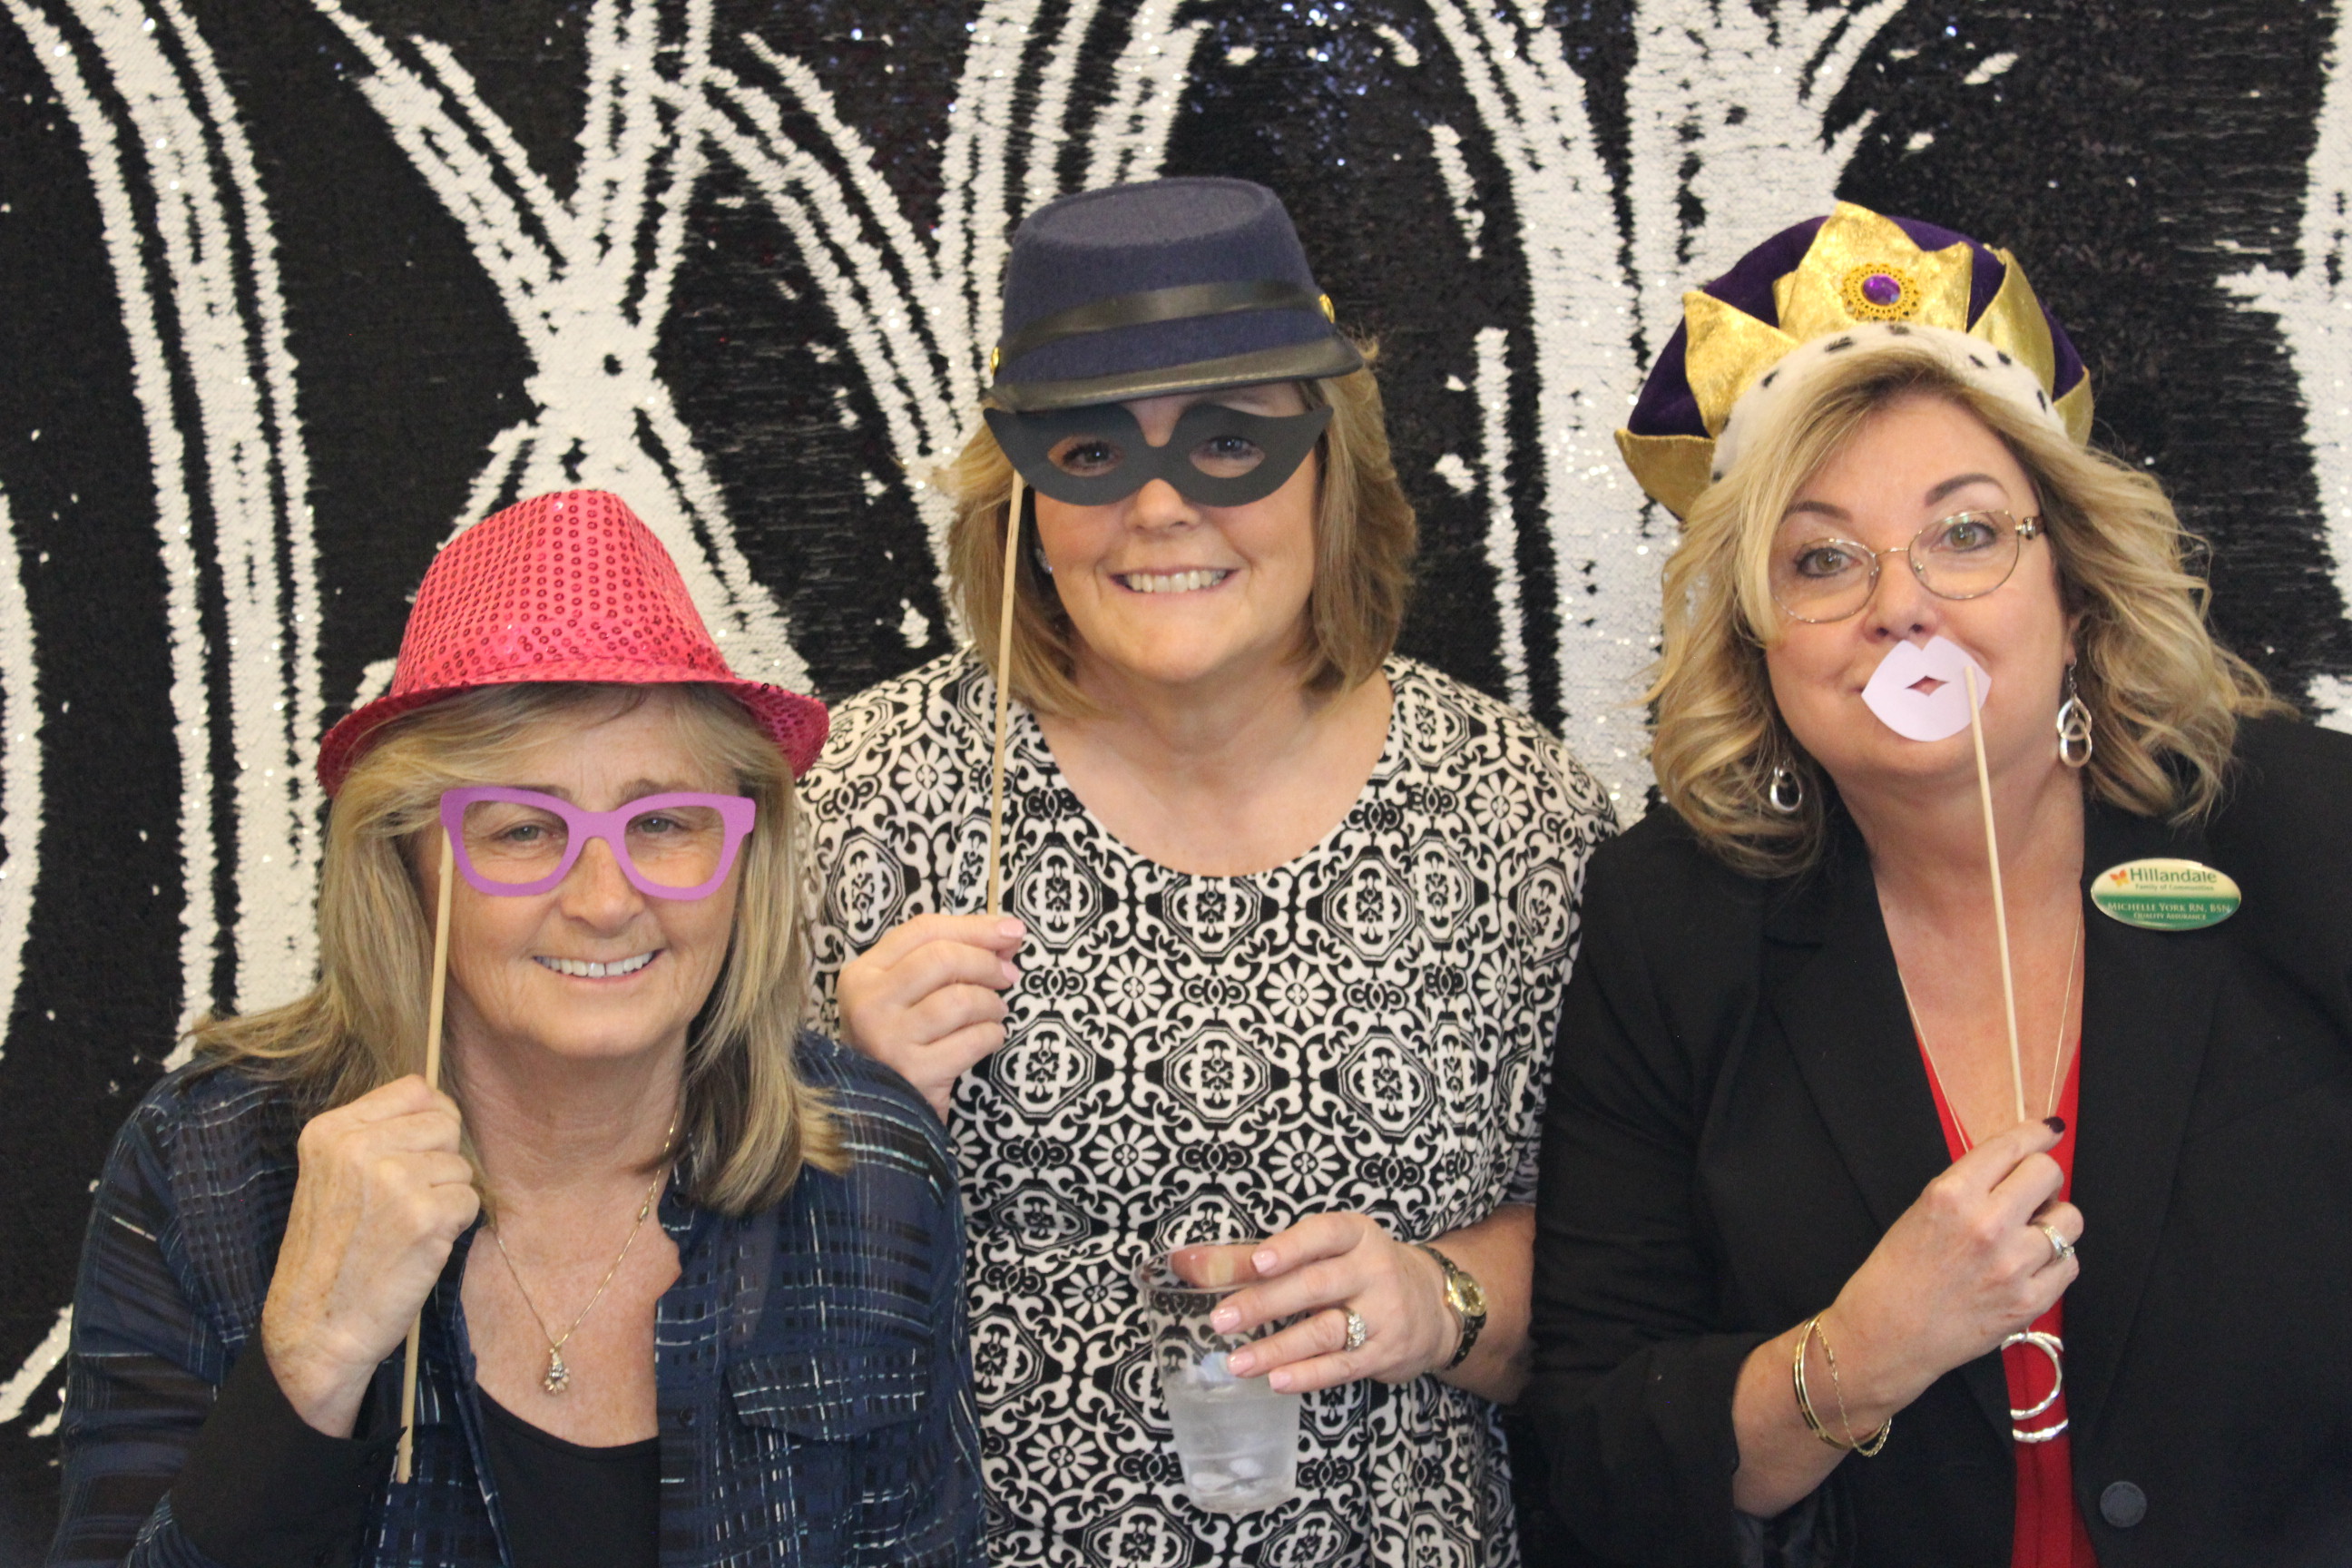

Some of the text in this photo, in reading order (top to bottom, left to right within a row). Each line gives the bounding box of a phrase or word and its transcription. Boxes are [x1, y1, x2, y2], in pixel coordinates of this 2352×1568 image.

[2130, 868, 2217, 883] Hillandale
[2107, 903, 2156, 912] MICHELLE
[2159, 903, 2186, 913] YORK
[2210, 904, 2230, 913] BSN
